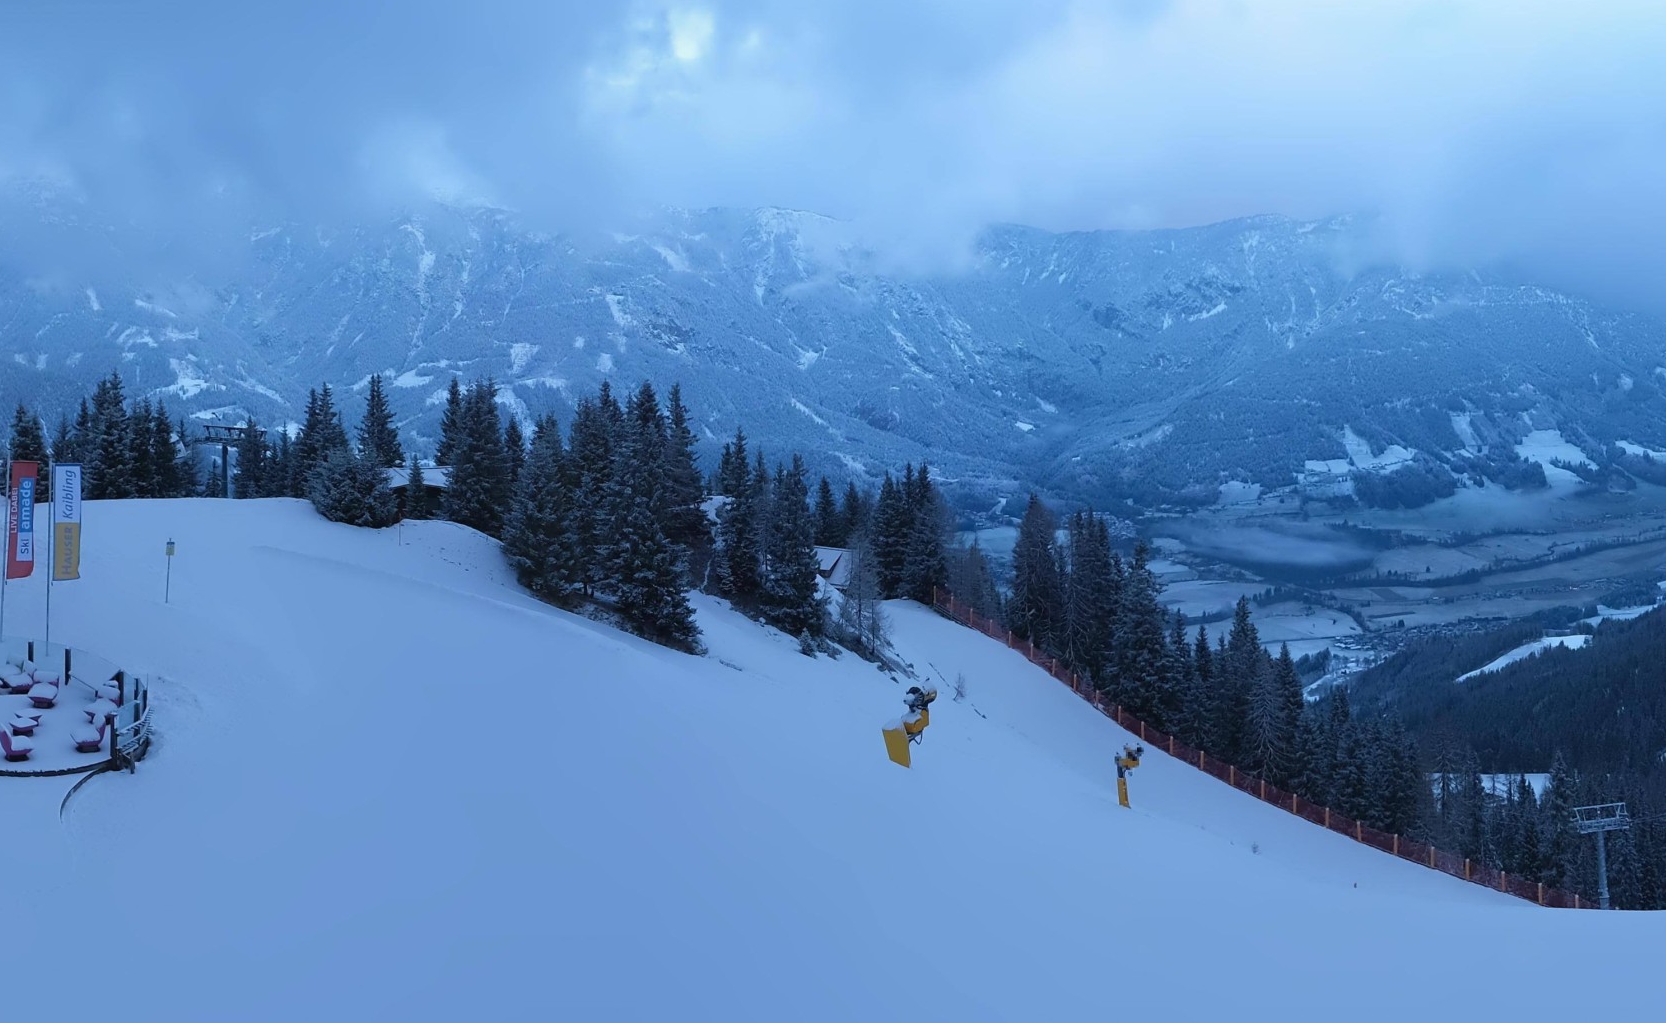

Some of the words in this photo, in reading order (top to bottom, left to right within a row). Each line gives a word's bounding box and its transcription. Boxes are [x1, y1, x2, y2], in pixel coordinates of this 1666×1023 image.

[62, 469, 77, 520] Kaibling
[10, 513, 18, 534] LIVE
[20, 538, 30, 554] Ski
[61, 527, 73, 575] HAUSER
